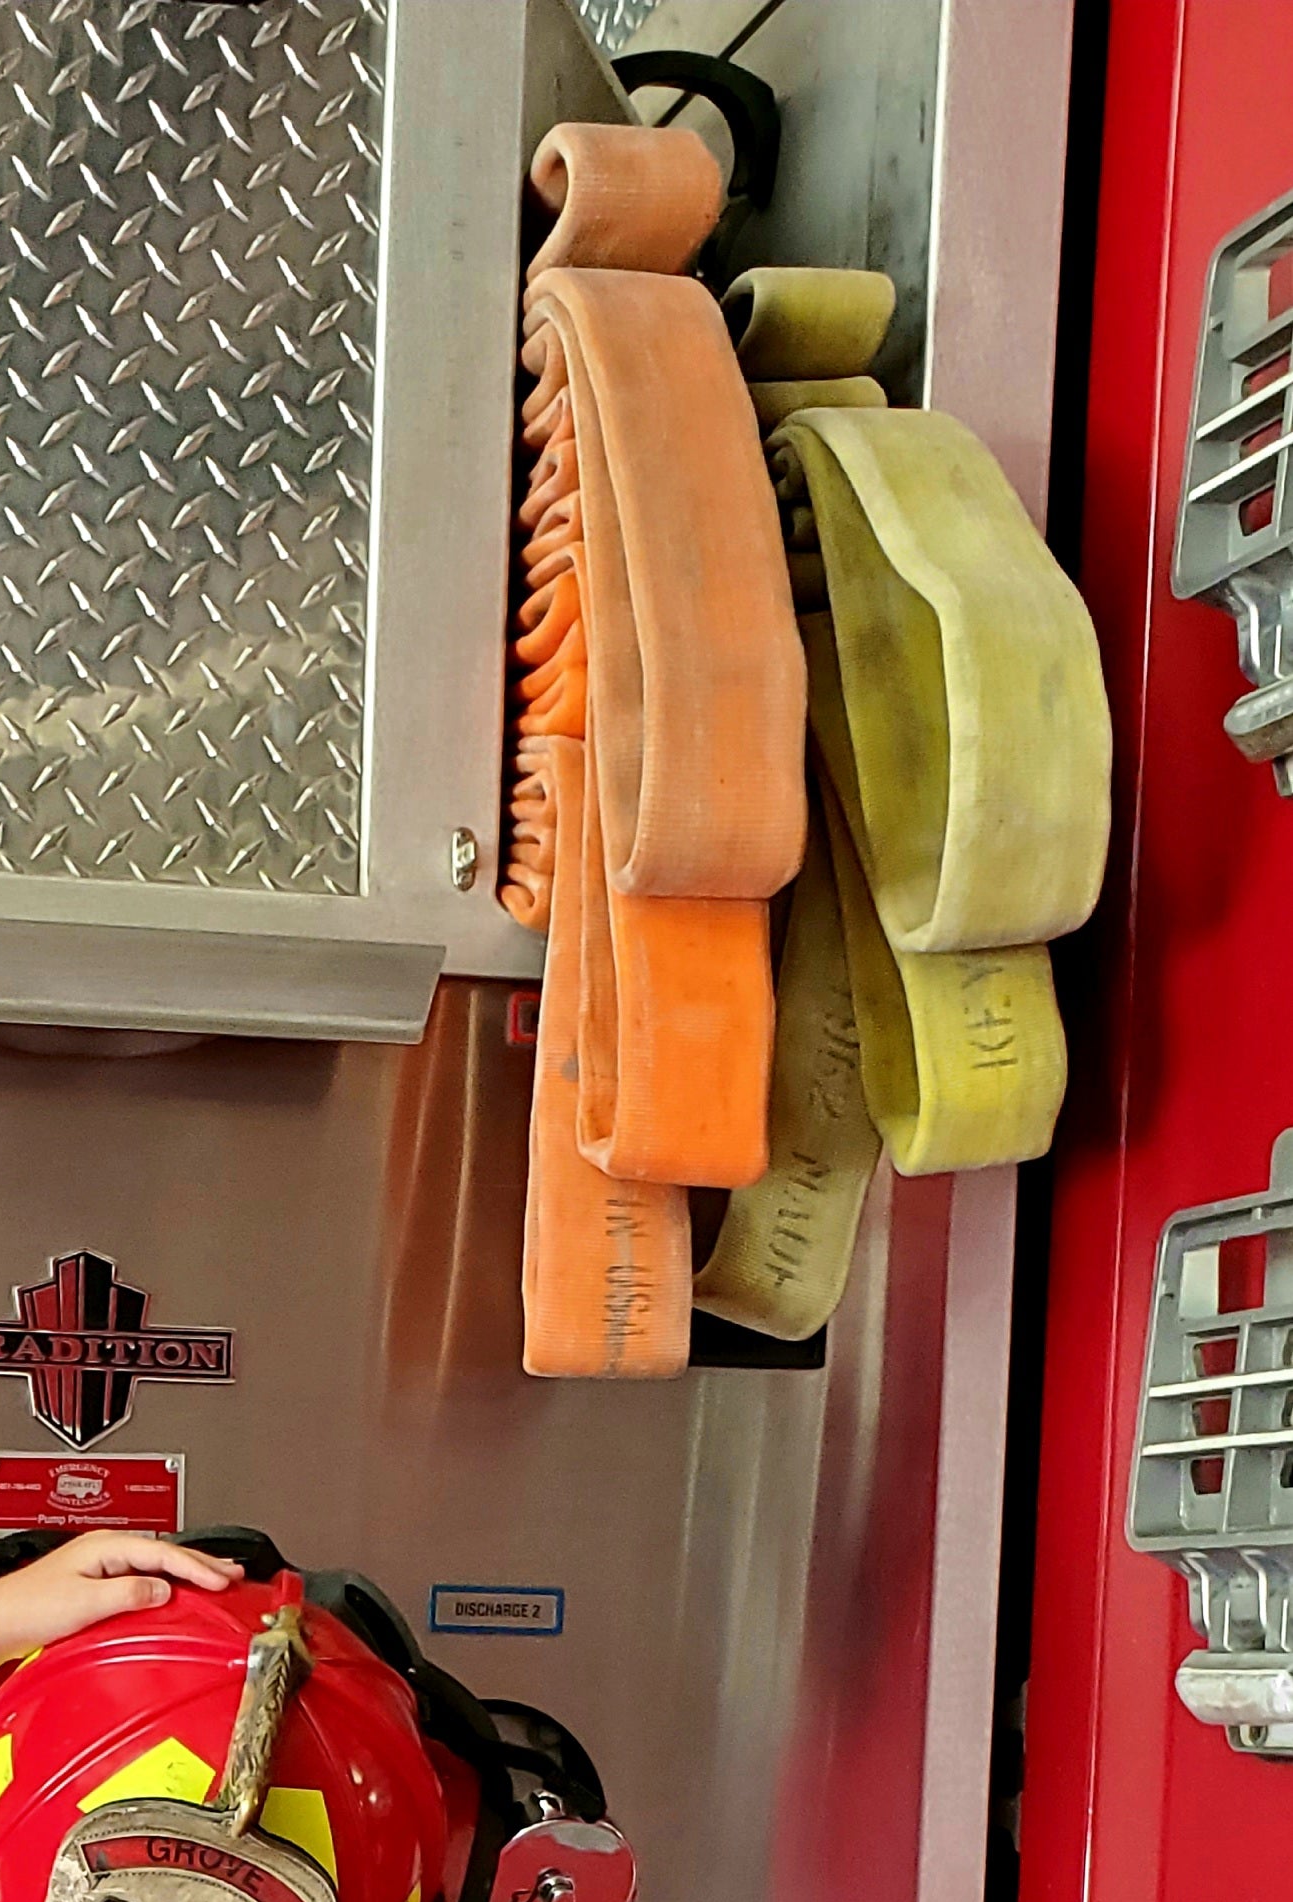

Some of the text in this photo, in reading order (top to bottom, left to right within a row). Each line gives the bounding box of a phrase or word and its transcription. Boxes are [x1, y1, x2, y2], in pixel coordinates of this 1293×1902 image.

[37, 1514, 67, 1526] Pump
[455, 1602, 540, 1618] DISCHARGE 2
[146, 1837, 265, 1892] GROVE
